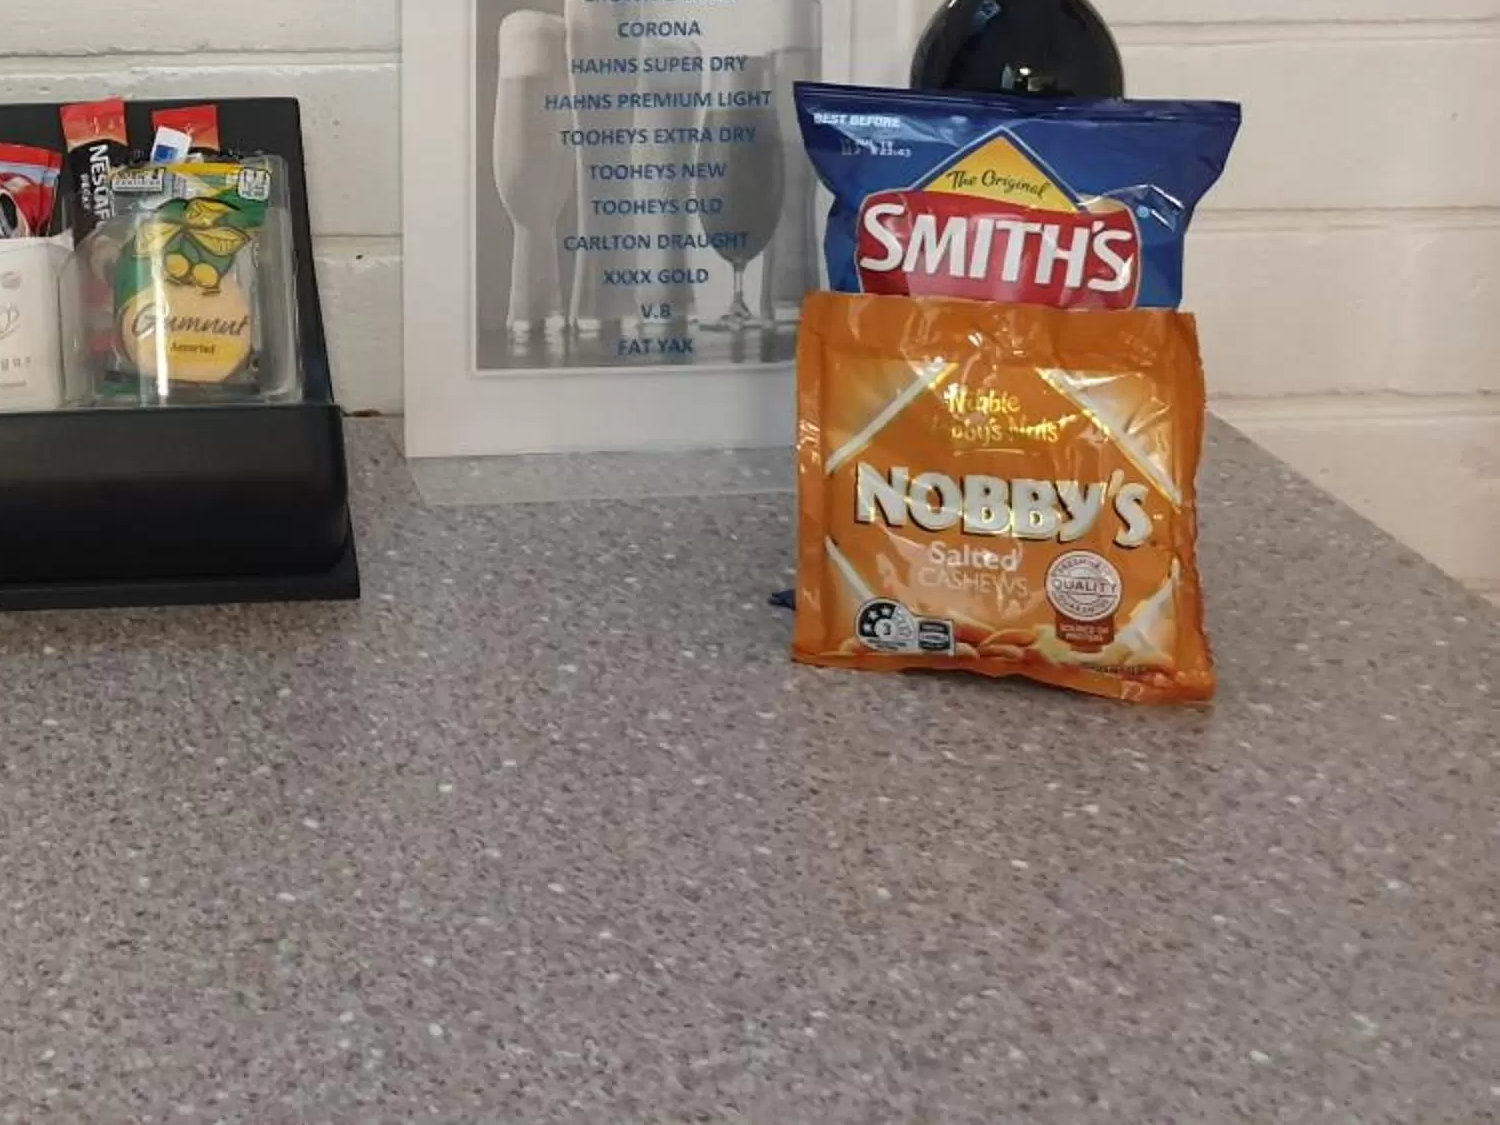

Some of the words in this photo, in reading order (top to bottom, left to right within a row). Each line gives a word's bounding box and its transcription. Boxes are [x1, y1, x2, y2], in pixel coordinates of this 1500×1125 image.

[617, 21, 702, 38] CORONA
[571, 57, 638, 75] HAHNS
[643, 56, 704, 74] SUPER
[710, 55, 748, 72] DRY
[544, 93, 612, 110] HAHNS
[617, 91, 713, 109] PREMIUM
[717, 90, 772, 107] LIGHT
[813, 113, 847, 124] BEST
[560, 128, 648, 146] TOOHEYS
[654, 128, 713, 145] EXTRA
[719, 126, 757, 143] DRY
[88, 144, 116, 220] NESCAF
[589, 163, 677, 181] TOOHEYS
[682, 163, 727, 180] NEW
[945, 170, 978, 190] The
[981, 169, 1052, 200] Original
[591, 198, 679, 216] TOOHEYS
[684, 198, 723, 215] OLD
[563, 234, 652, 252] CARLTON
[657, 232, 749, 251] DRAUGHT
[860, 203, 1136, 294] SMITH'S
[603, 269, 652, 285] XXXX
[657, 268, 709, 284] GOLD
[617, 339, 654, 356] FAT
[657, 338, 694, 354] YAK
[930, 540, 1019, 573] Salted
[918, 566, 1029, 598] CASHEWS
[1050, 577, 1117, 595] QUALITY
